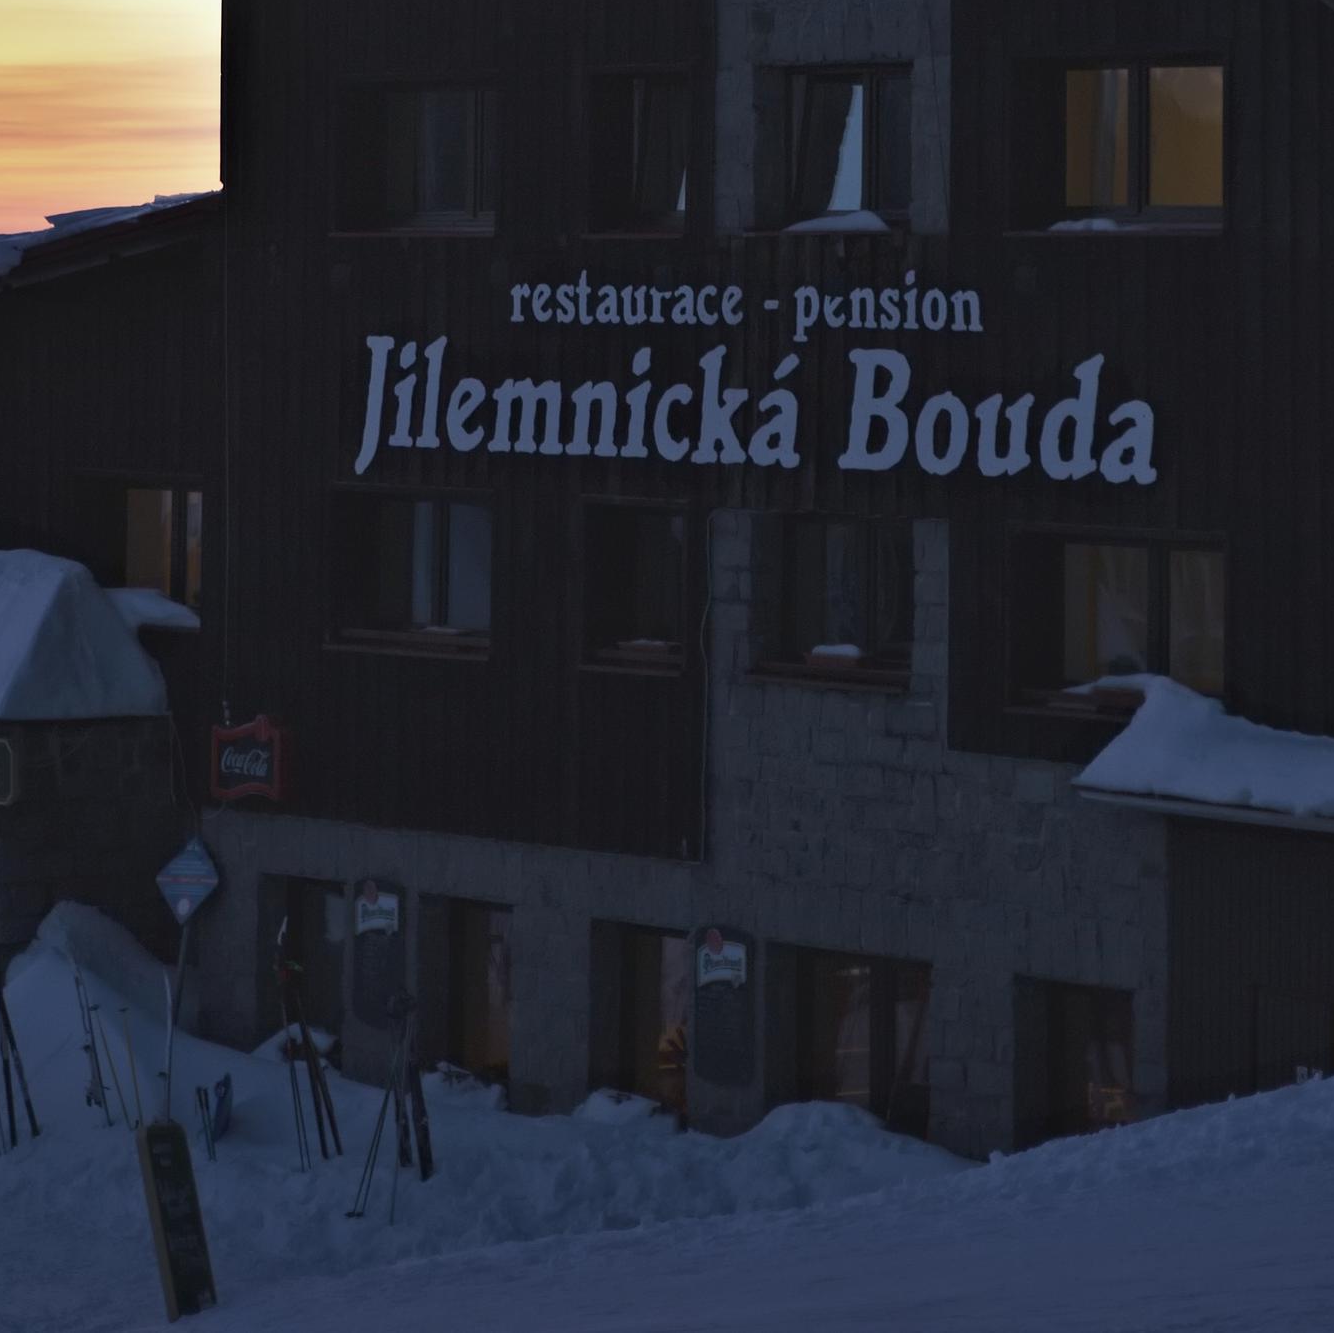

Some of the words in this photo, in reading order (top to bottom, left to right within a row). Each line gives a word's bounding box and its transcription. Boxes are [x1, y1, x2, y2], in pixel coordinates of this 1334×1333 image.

[510, 269, 743, 326] restaurace
[793, 269, 983, 342] pension
[354, 335, 800, 475] Jilemnická
[837, 347, 1157, 485] Bouda
